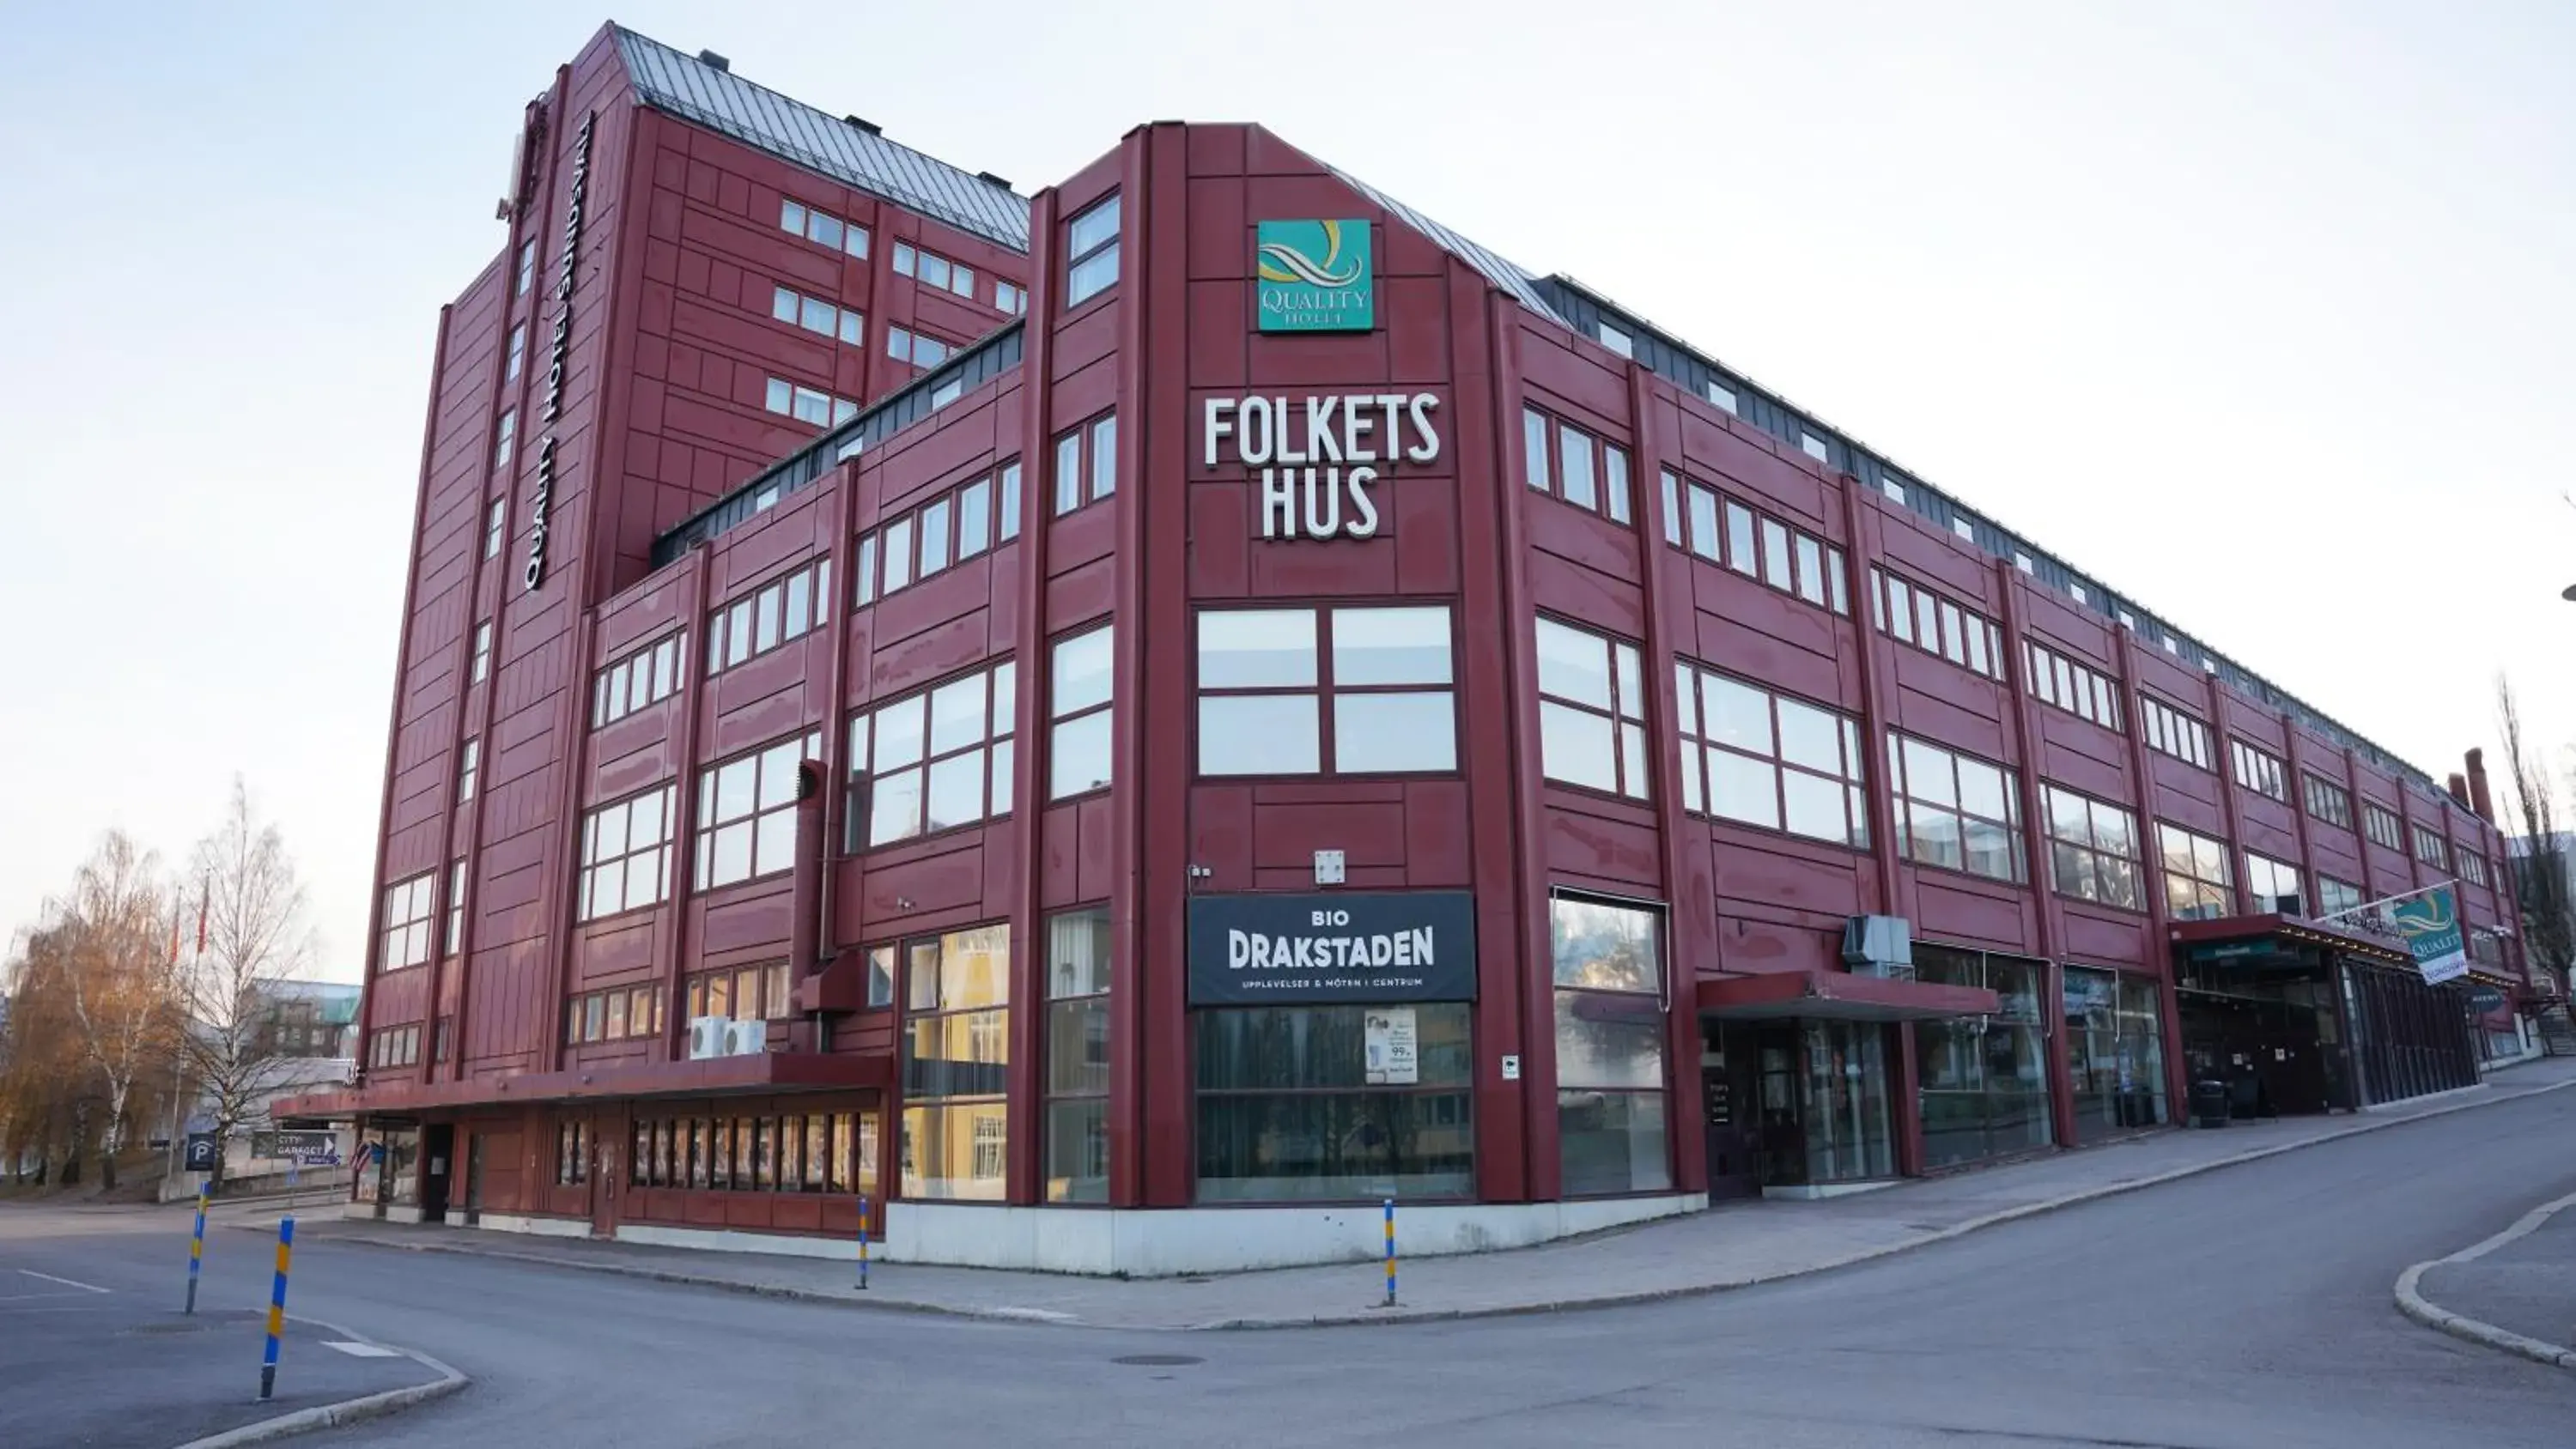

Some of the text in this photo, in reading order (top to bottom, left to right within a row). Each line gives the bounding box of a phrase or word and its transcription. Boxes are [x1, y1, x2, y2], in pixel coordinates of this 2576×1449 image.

[1262, 288, 1369, 313] QUALITY
[524, 110, 594, 591] QUALITY HOTEL SUNDSVALL
[1205, 392, 1440, 468] FOLKETS
[1261, 466, 1379, 542] HUS
[1311, 910, 1350, 927] BIO
[1229, 925, 1435, 969] DRAKSTADEN
[1242, 980, 1309, 989] UPPLEVELSER
[1373, 978, 1423, 987] CENTRUM
